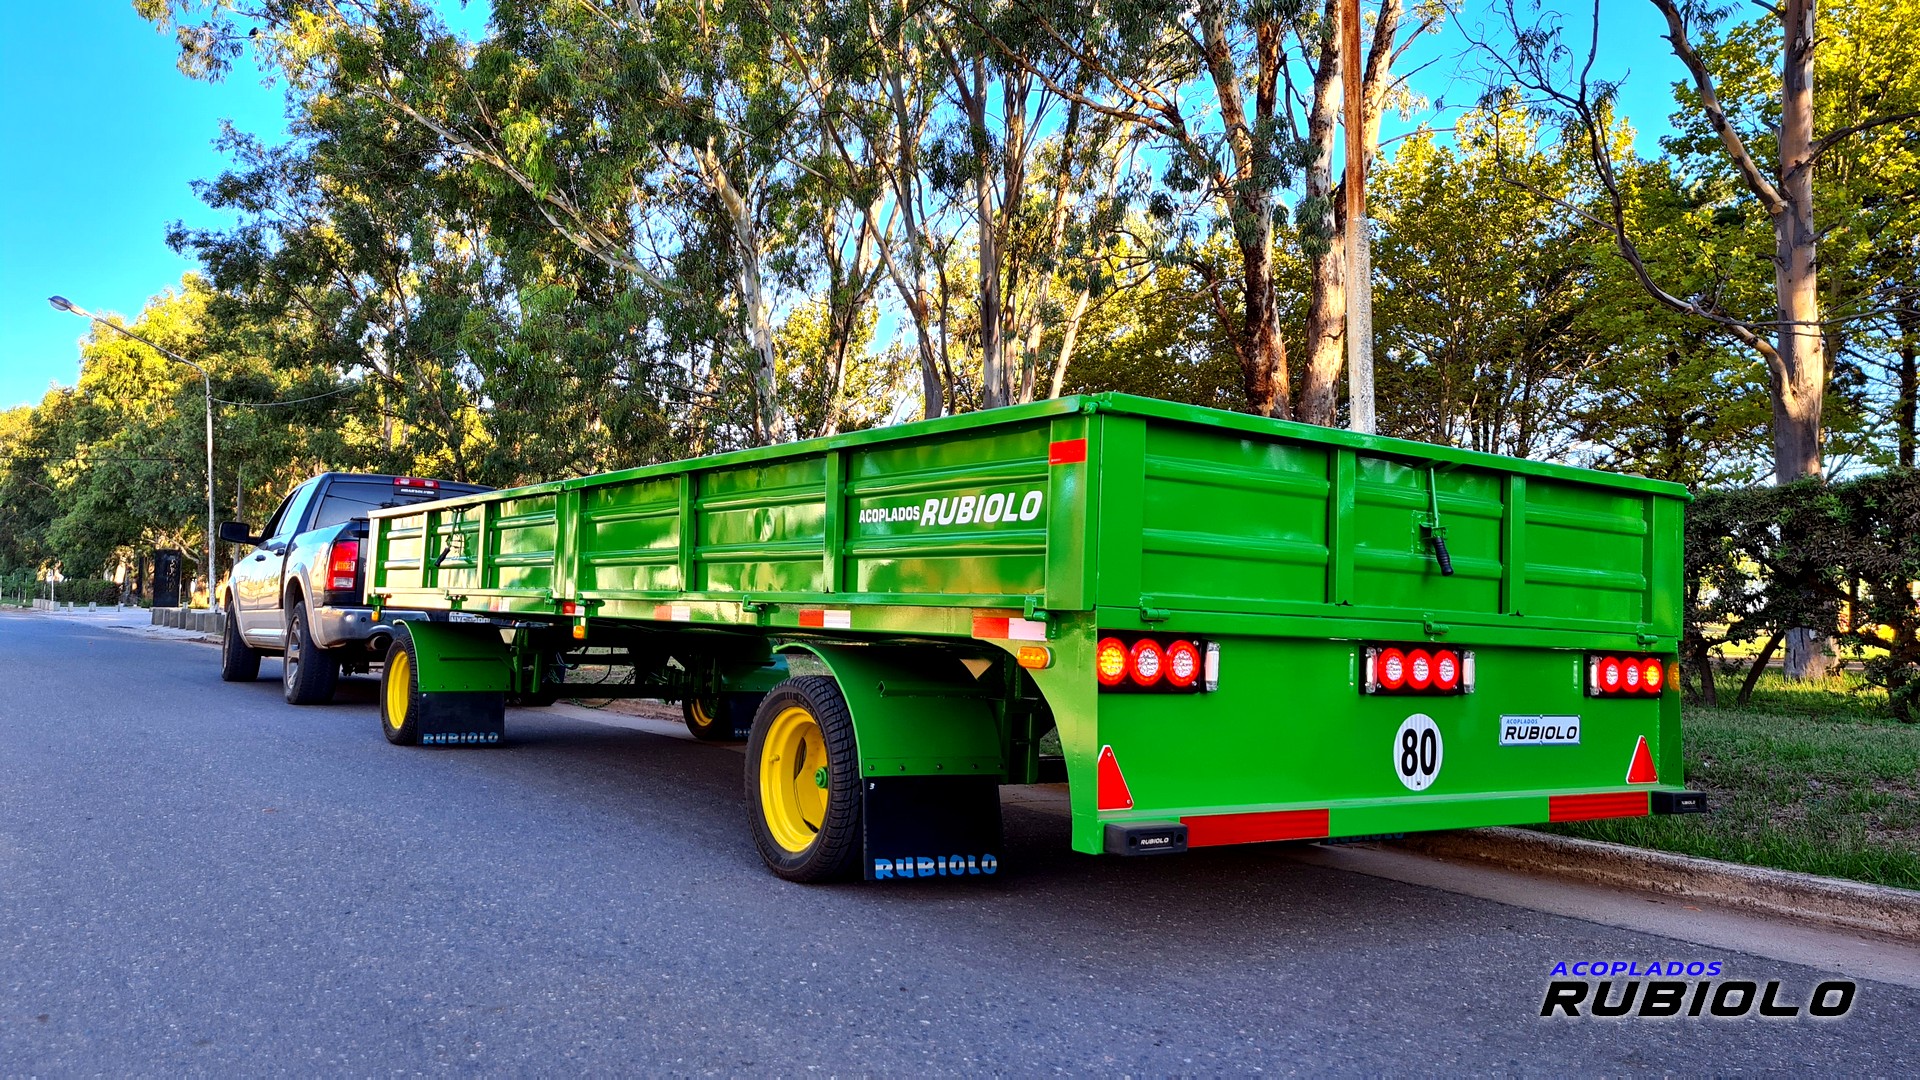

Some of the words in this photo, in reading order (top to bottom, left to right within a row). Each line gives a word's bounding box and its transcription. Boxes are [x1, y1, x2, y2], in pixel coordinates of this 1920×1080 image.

[859, 506, 920, 523] ACOPLADOS
[920, 490, 1043, 526] RUBIOLO
[423, 732, 498, 744] RUBIOLO
[1505, 726, 1577, 740] RUBIOLO
[1401, 728, 1436, 776] 80
[1141, 837, 1169, 845] RUBIOLO
[874, 854, 998, 880] RUBIOLO
